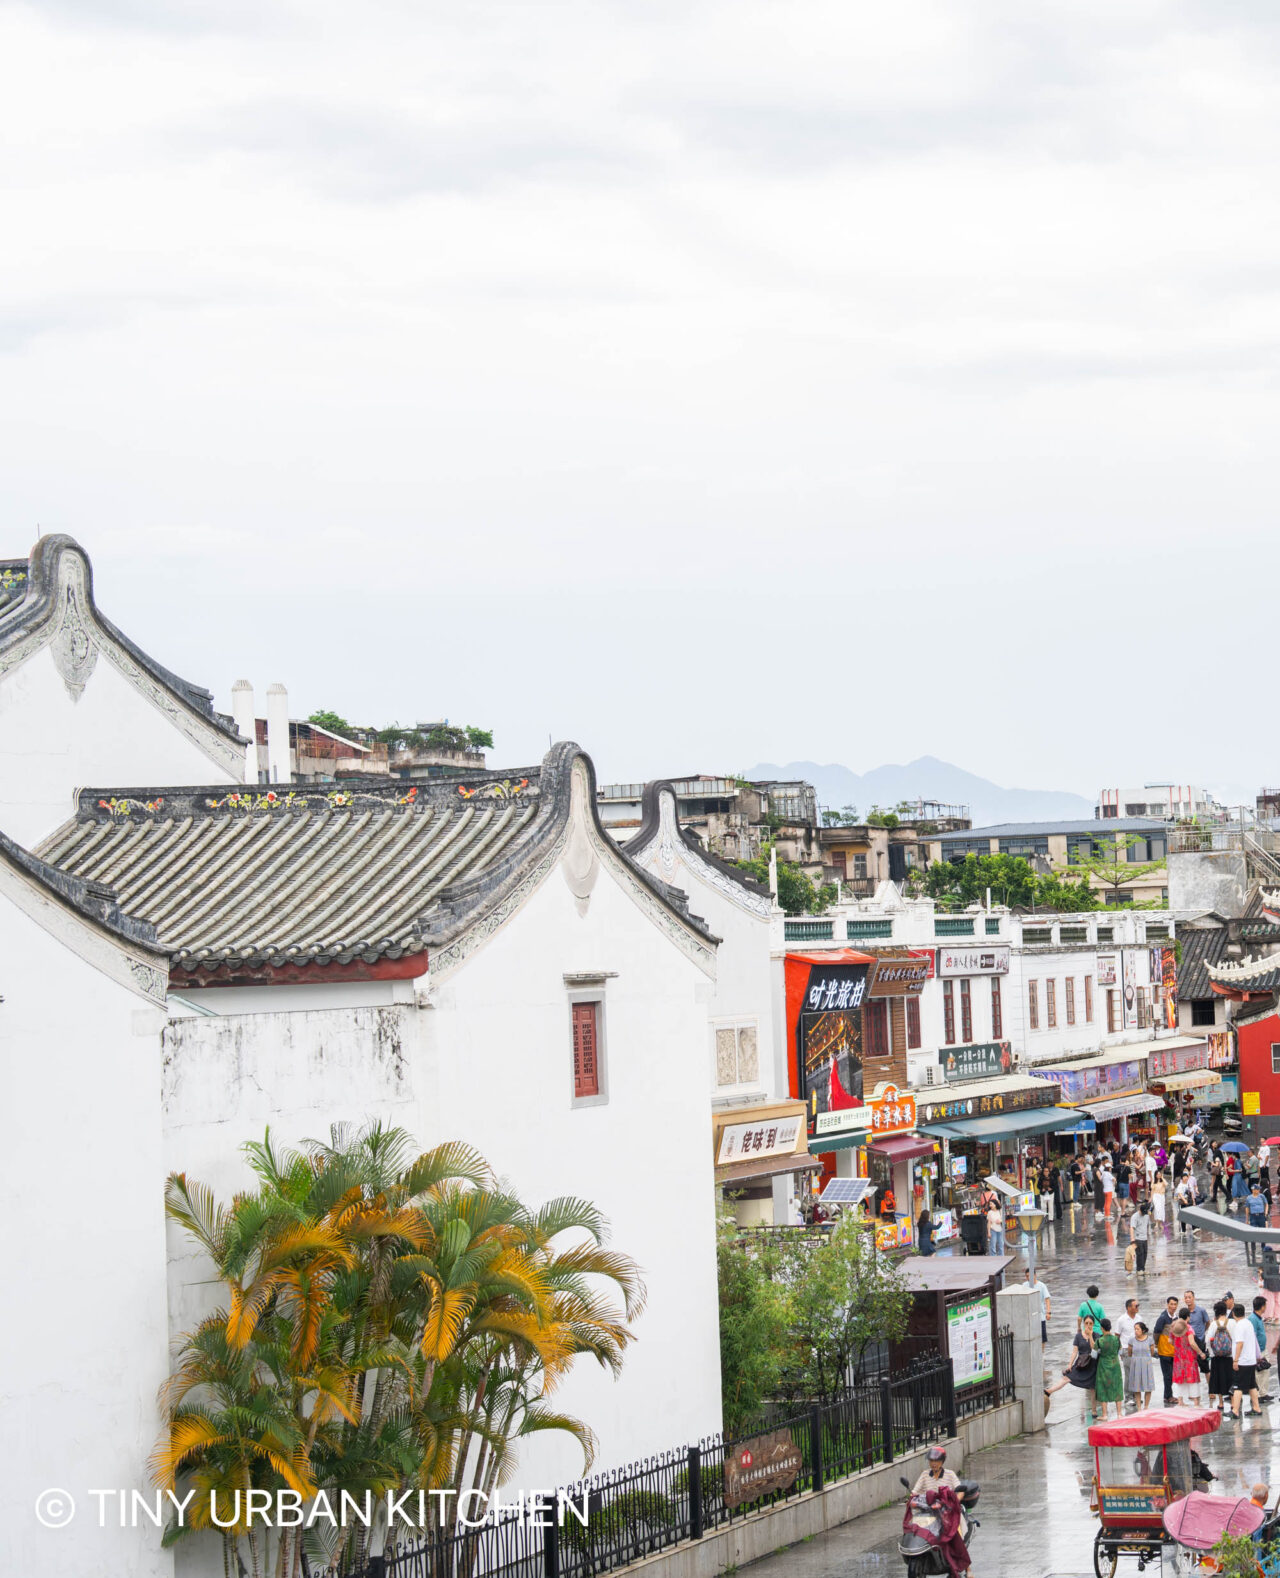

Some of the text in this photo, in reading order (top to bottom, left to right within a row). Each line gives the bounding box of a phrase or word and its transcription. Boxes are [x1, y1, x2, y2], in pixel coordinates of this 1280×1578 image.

[809, 977, 865, 1010] 时光旅拍
[872, 1104, 912, 1129] 甘草水果
